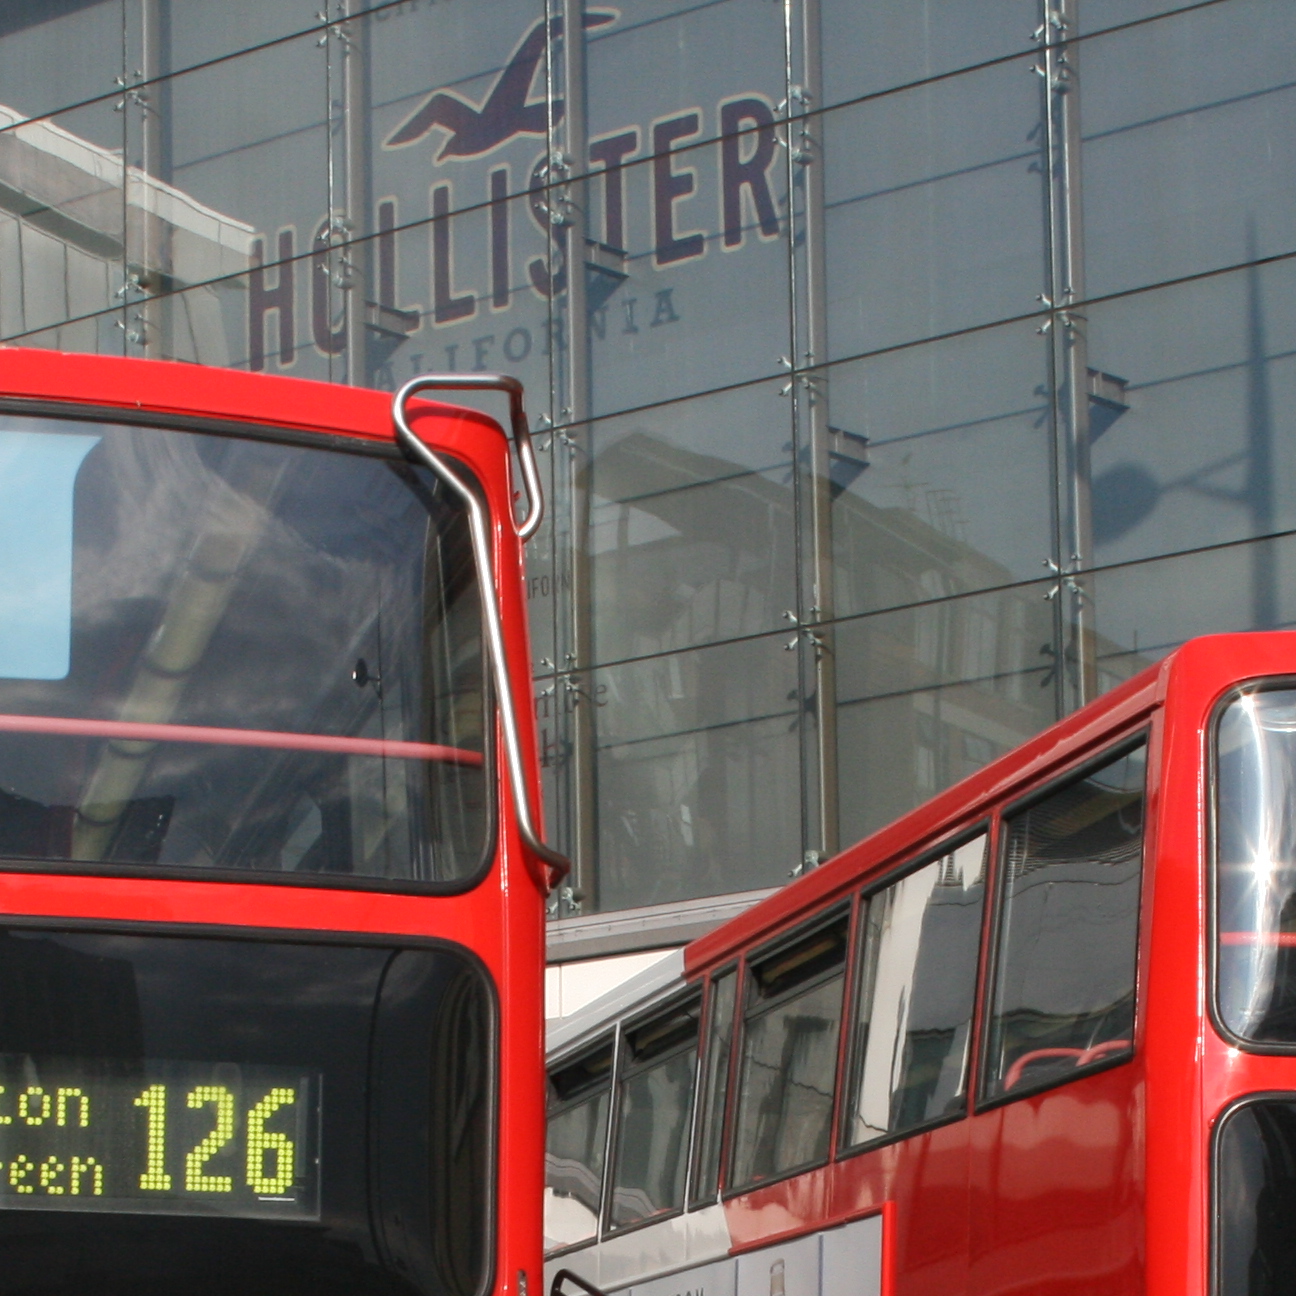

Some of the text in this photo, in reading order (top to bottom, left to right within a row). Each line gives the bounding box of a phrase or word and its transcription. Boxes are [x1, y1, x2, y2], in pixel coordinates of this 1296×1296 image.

[248, 92, 784, 372] HOLLISTER
[342, 288, 680, 396] ALIFORNIA
[134, 1083, 296, 1194] 126
